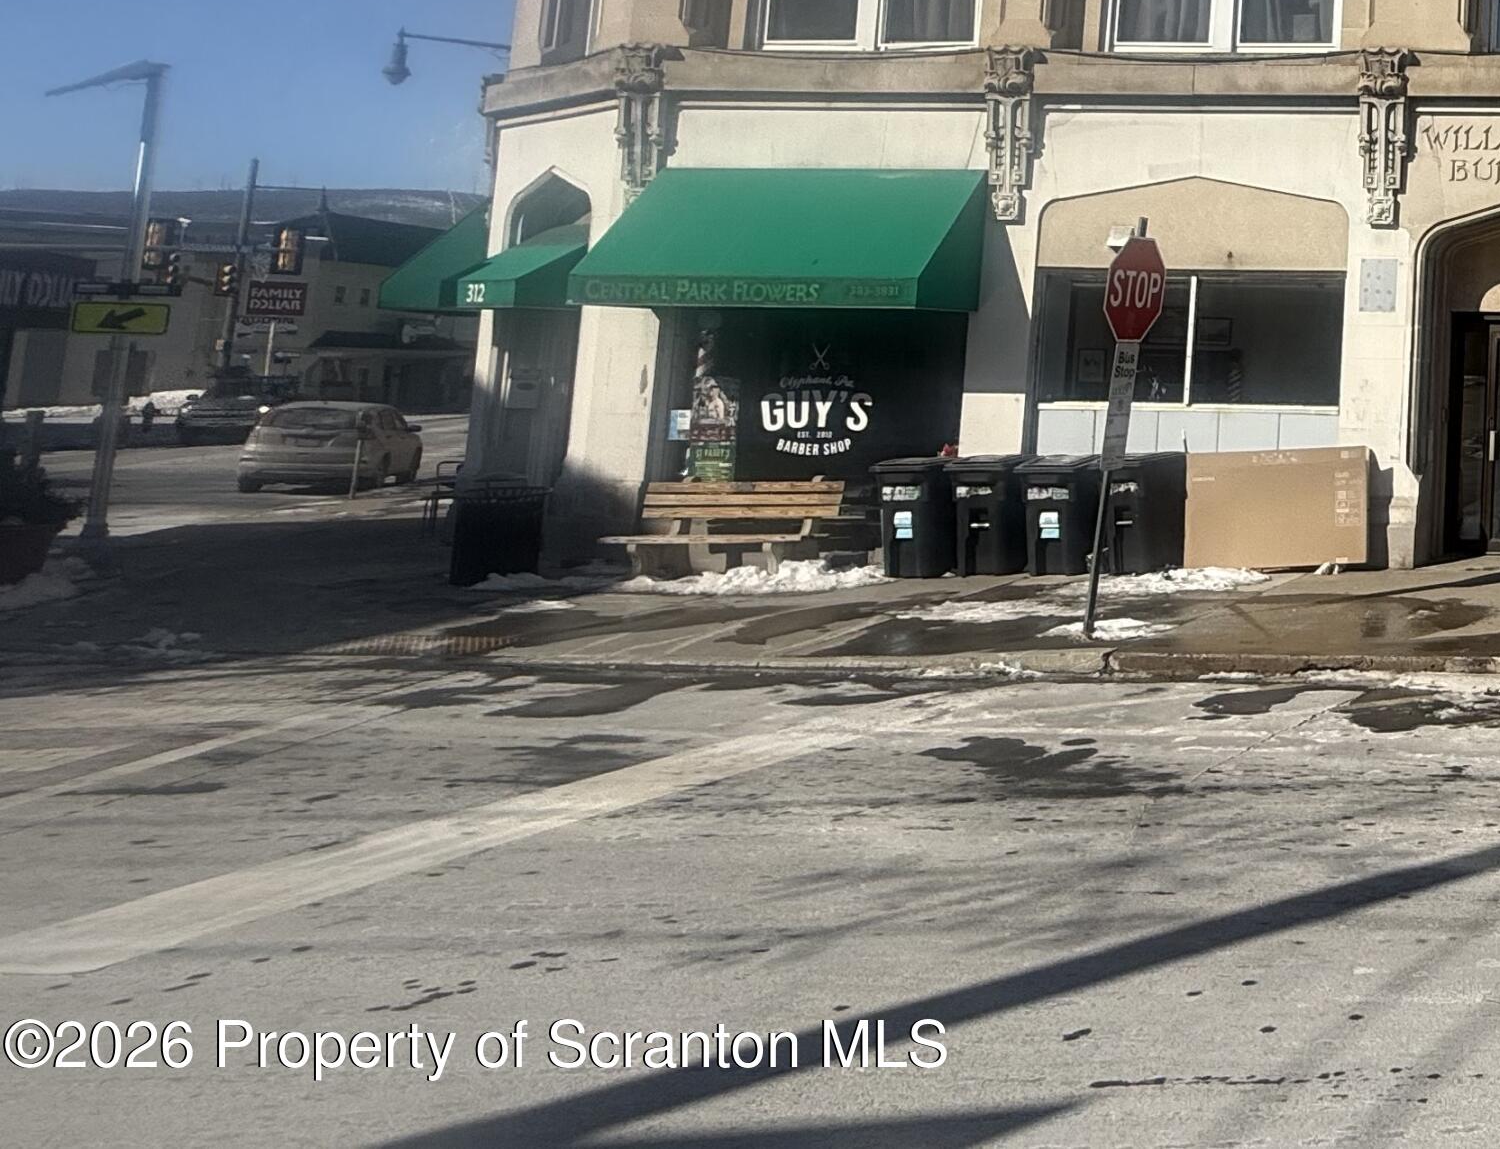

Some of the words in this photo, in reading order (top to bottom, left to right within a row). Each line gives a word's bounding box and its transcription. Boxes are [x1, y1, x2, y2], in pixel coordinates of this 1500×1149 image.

[250, 287, 303, 299] FAMILY
[466, 283, 486, 302] 312
[585, 279, 670, 300] CENTRAL
[676, 279, 728, 301] PARK
[733, 280, 820, 302] FLOWERS
[1109, 269, 1161, 308] STOP
[249, 298, 302, 310] DOLLAR
[1118, 351, 1136, 364] Bus
[1113, 365, 1135, 380] Stop
[761, 390, 873, 432] GUY'S
[776, 438, 820, 456] BARBER
[823, 438, 852, 456] SHOP
